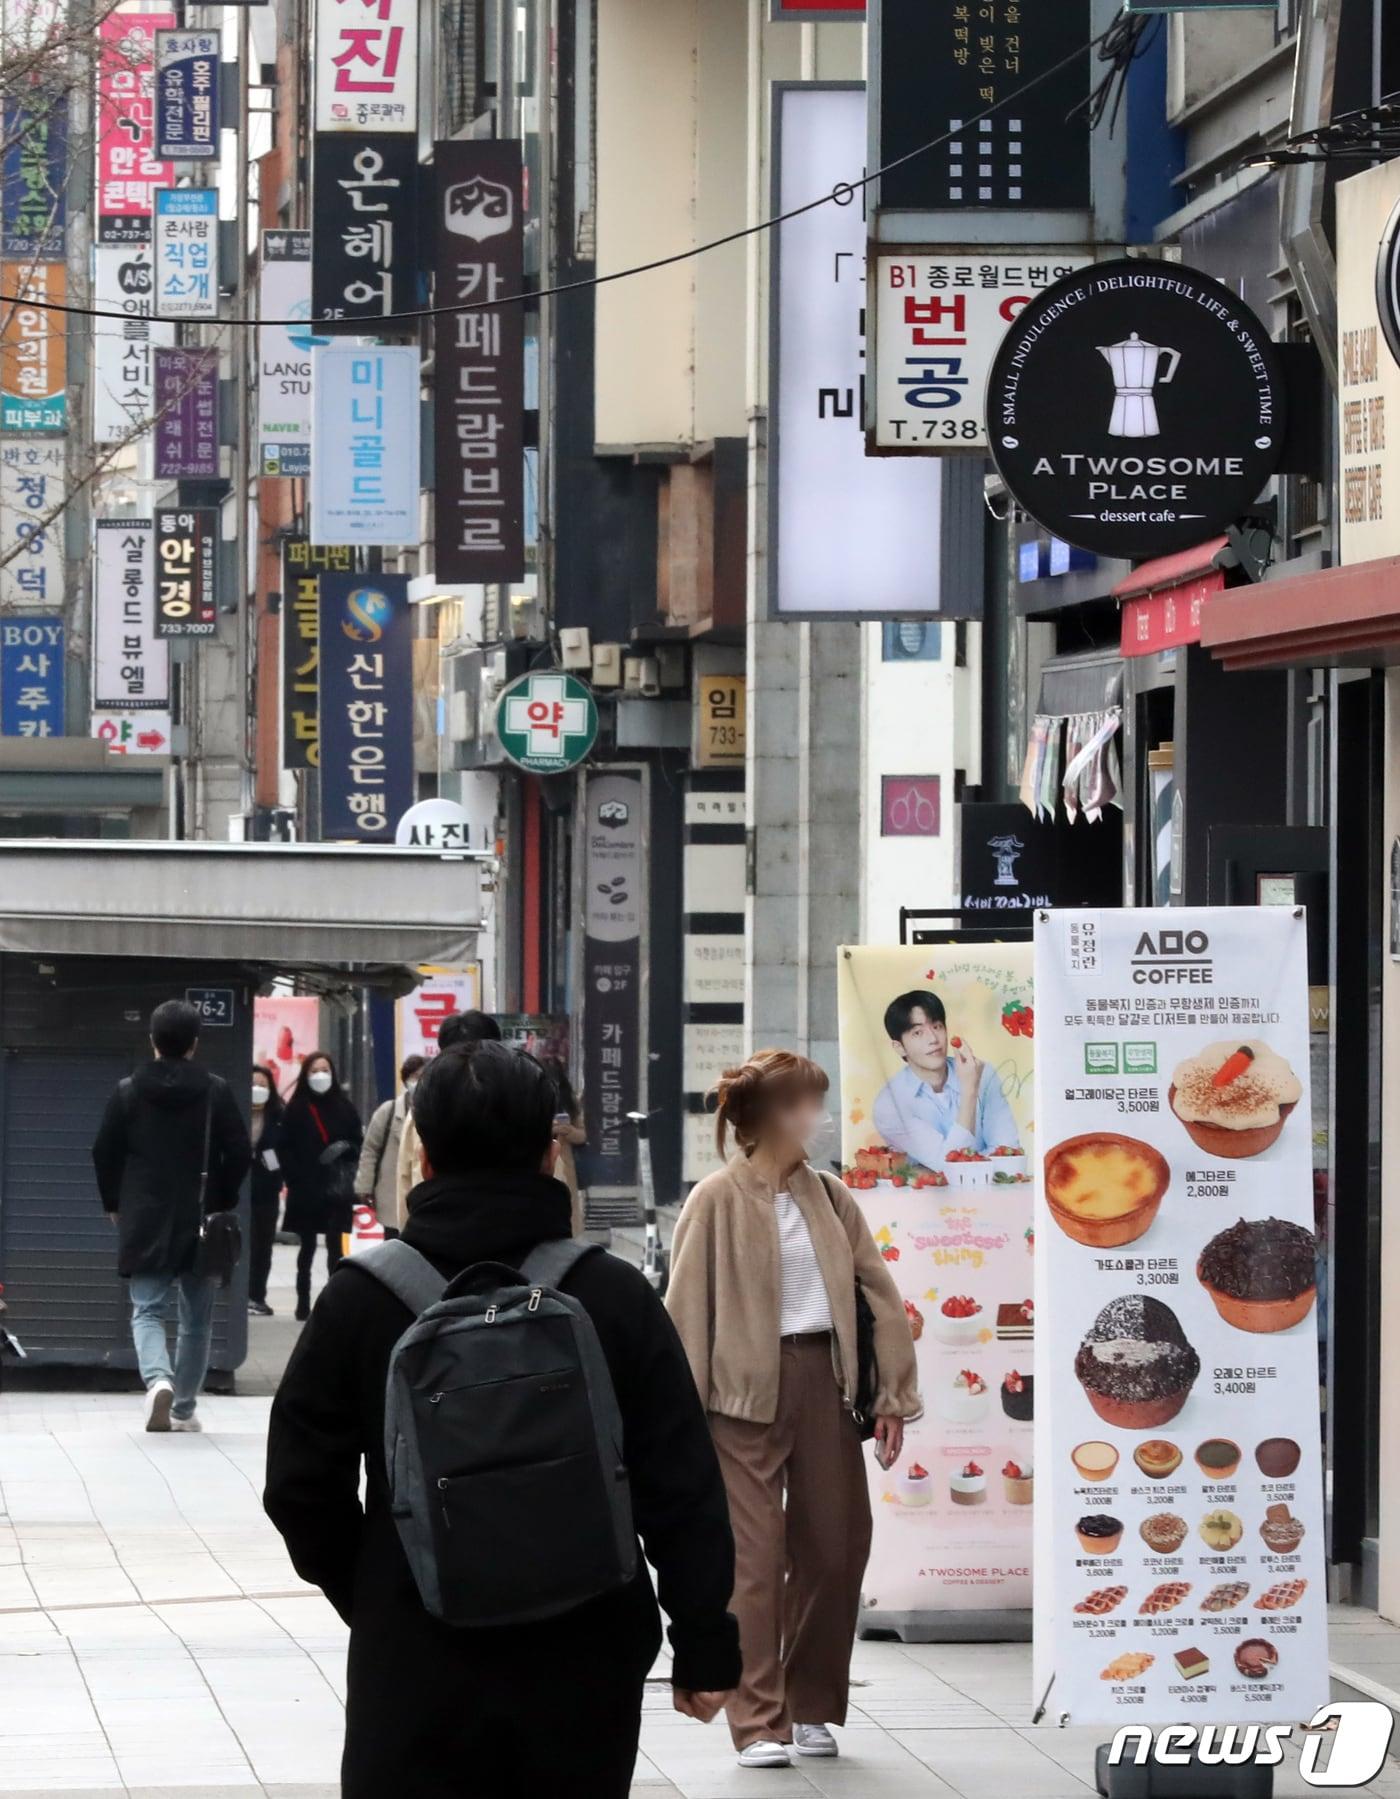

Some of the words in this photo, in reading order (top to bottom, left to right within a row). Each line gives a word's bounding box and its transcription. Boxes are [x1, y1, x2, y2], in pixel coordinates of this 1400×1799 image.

[953, 7, 970, 66] 복떡방
[979, 36, 995, 75] 빚은
[1005, 36, 1020, 74] 건너
[979, 86, 995, 103] 떡
[109, 147, 164, 175] 안경
[164, 243, 208, 268] 직업
[124, 269, 149, 287] A/S
[890, 265, 916, 288] B1
[164, 274, 209, 299] 소개
[122, 300, 150, 406] 애플서비스
[1003, 372, 1020, 425] SMALL
[1012, 288, 1086, 368] INDULGENCE
[1097, 275, 1194, 300] DELIGHTFUL
[1196, 293, 1229, 321] LIFE
[1226, 318, 1240, 332] &
[1237, 331, 1269, 381] SWEET
[1258, 384, 1273, 425] TIME
[263, 362, 311, 376] LANG
[280, 381, 311, 394] STU
[898, 357, 968, 409] 공
[6, 410, 62, 427] 피부과
[350, 357, 386, 504] 미니골드
[1032, 457, 1055, 475] A
[1061, 454, 1244, 476] TWOSOME
[1088, 482, 1188, 500] PLACE
[160, 514, 195, 533] 동아
[1100, 510, 1147, 522] dessert
[1149, 510, 1176, 522] cafe
[160, 539, 195, 617] 안경
[4, 627, 61, 645] BOY
[160, 624, 215, 634] 733-7007
[527, 701, 565, 738] 약
[347, 654, 388, 831] 신한은행
[520, 757, 570, 768] PHARMACY
[614, 980, 627, 991] 2F
[1132, 969, 1213, 985] COFFEE
[1086, 999, 1130, 1012] 동물복지
[1134, 998, 1166, 1011] 인증과
[1170, 998, 1215, 1011] 무항생제
[1218, 996, 1260, 1010] 인증까지
[1064, 1015, 1083, 1026] 모두
[1118, 1012, 1150, 1026] 달걀로
[1153, 1012, 1197, 1026] 디저트를
[1200, 1013, 1229, 1025] 만들어
[1232, 1012, 1280, 1025] 제공합니다
[1065, 1089, 1126, 1100] 얼그레이당근
[1128, 1088, 1160, 1100] 타르트
[1117, 1100, 1160, 1113] 3,500원
[1186, 1170, 1237, 1183] 에그타르트
[1187, 1185, 1230, 1198] 2,800원
[1095, 1259, 1145, 1271] 가또쇼콜라
[1147, 1258, 1179, 1271] 타르트
[1136, 1273, 1180, 1286] 3,300원
[1213, 1367, 1245, 1380] 오레오
[1246, 1367, 1278, 1379] 타르트
[1214, 1382, 1256, 1395] 3,400원
[1207, 1495, 1235, 1504] 3,500원
[1266, 1493, 1295, 1502] 3,500원
[919, 1568, 927, 1577] A
[929, 1568, 988, 1577] TWOSOME
[991, 1568, 1030, 1576] PLACE
